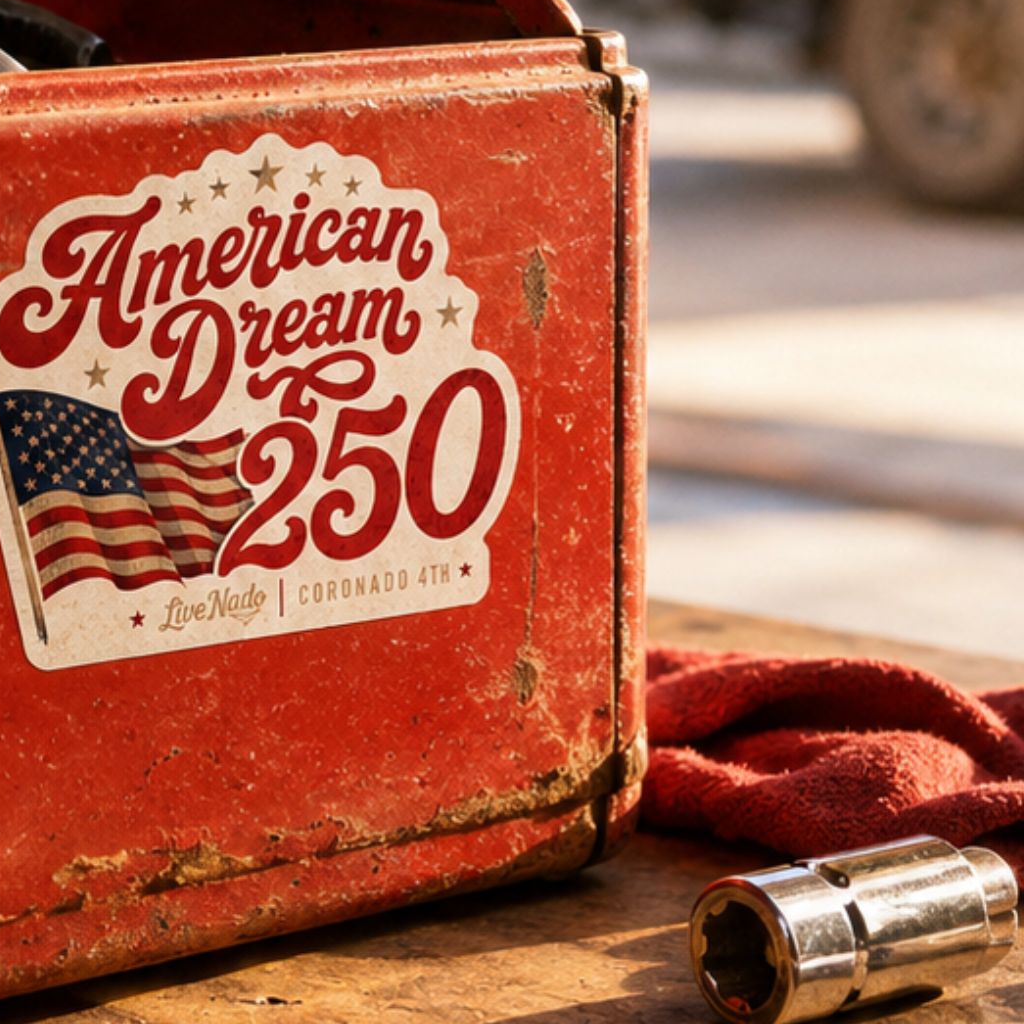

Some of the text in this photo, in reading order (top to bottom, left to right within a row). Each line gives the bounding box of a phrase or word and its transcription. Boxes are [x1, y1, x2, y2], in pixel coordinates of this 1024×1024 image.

[121, 287, 421, 441] Dream
[219, 367, 506, 577] 250
[298, 574, 409, 606] CORONADO
[416, 562, 452, 589] 4TH
